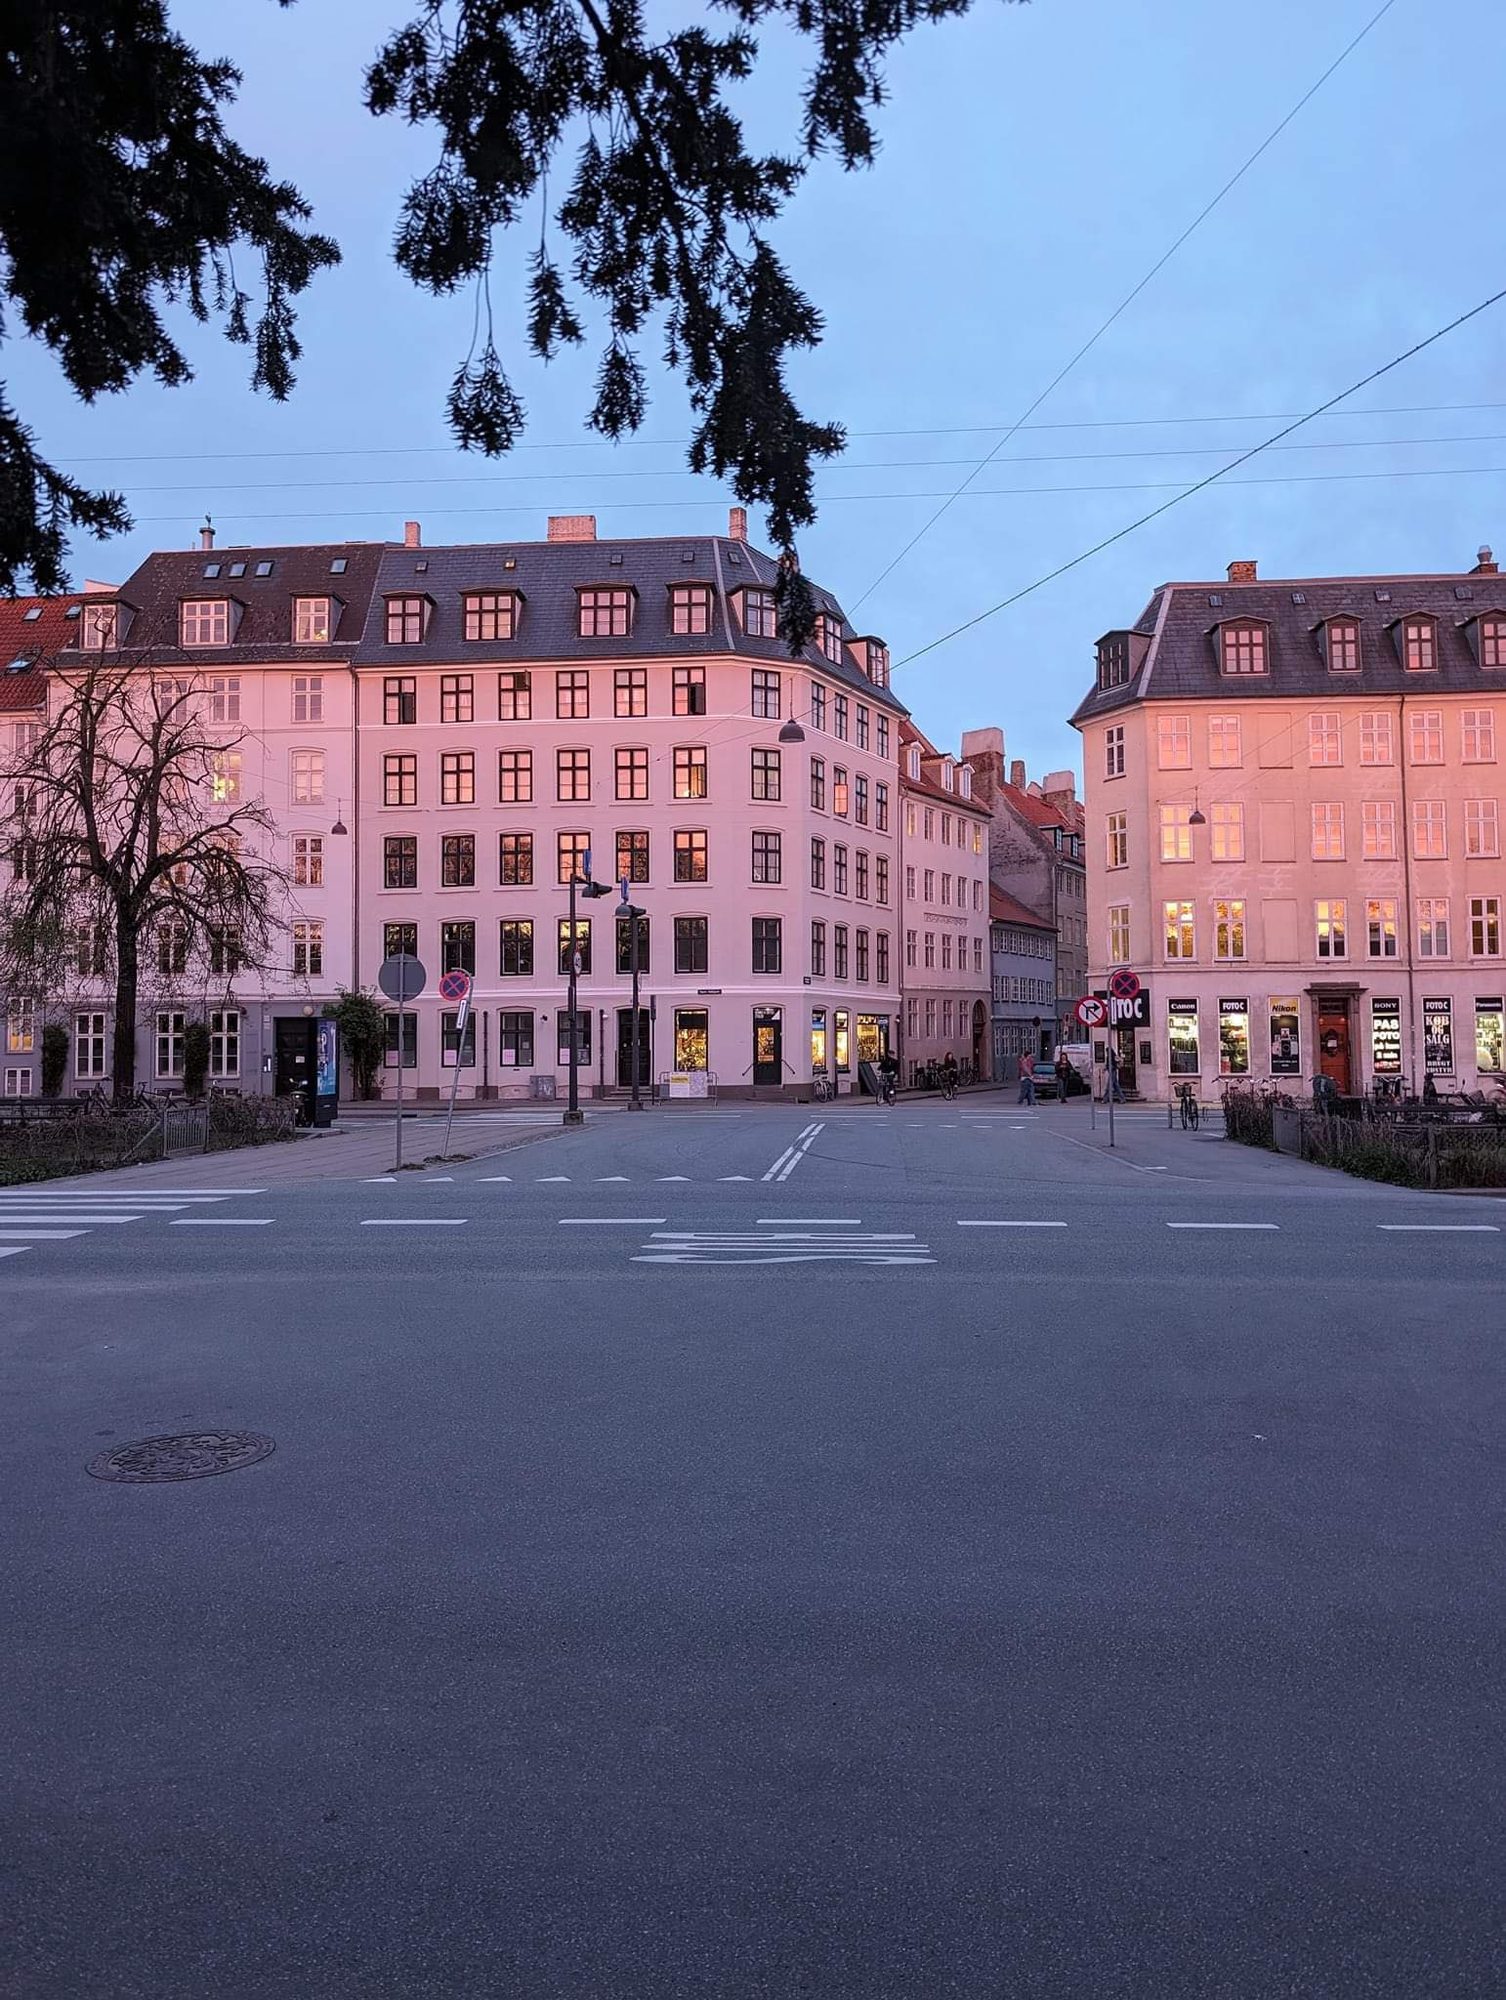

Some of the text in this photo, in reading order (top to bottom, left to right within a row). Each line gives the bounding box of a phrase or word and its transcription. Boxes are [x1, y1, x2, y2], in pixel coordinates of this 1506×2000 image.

[1271, 1004, 1297, 1012] Nikon
[1373, 1019, 1399, 1030] PAS
[1425, 1015, 1450, 1026] KØB
[1431, 1025, 1444, 1035] OG
[1373, 1031, 1400, 1040] FOTO
[1426, 1034, 1450, 1045] SALG
